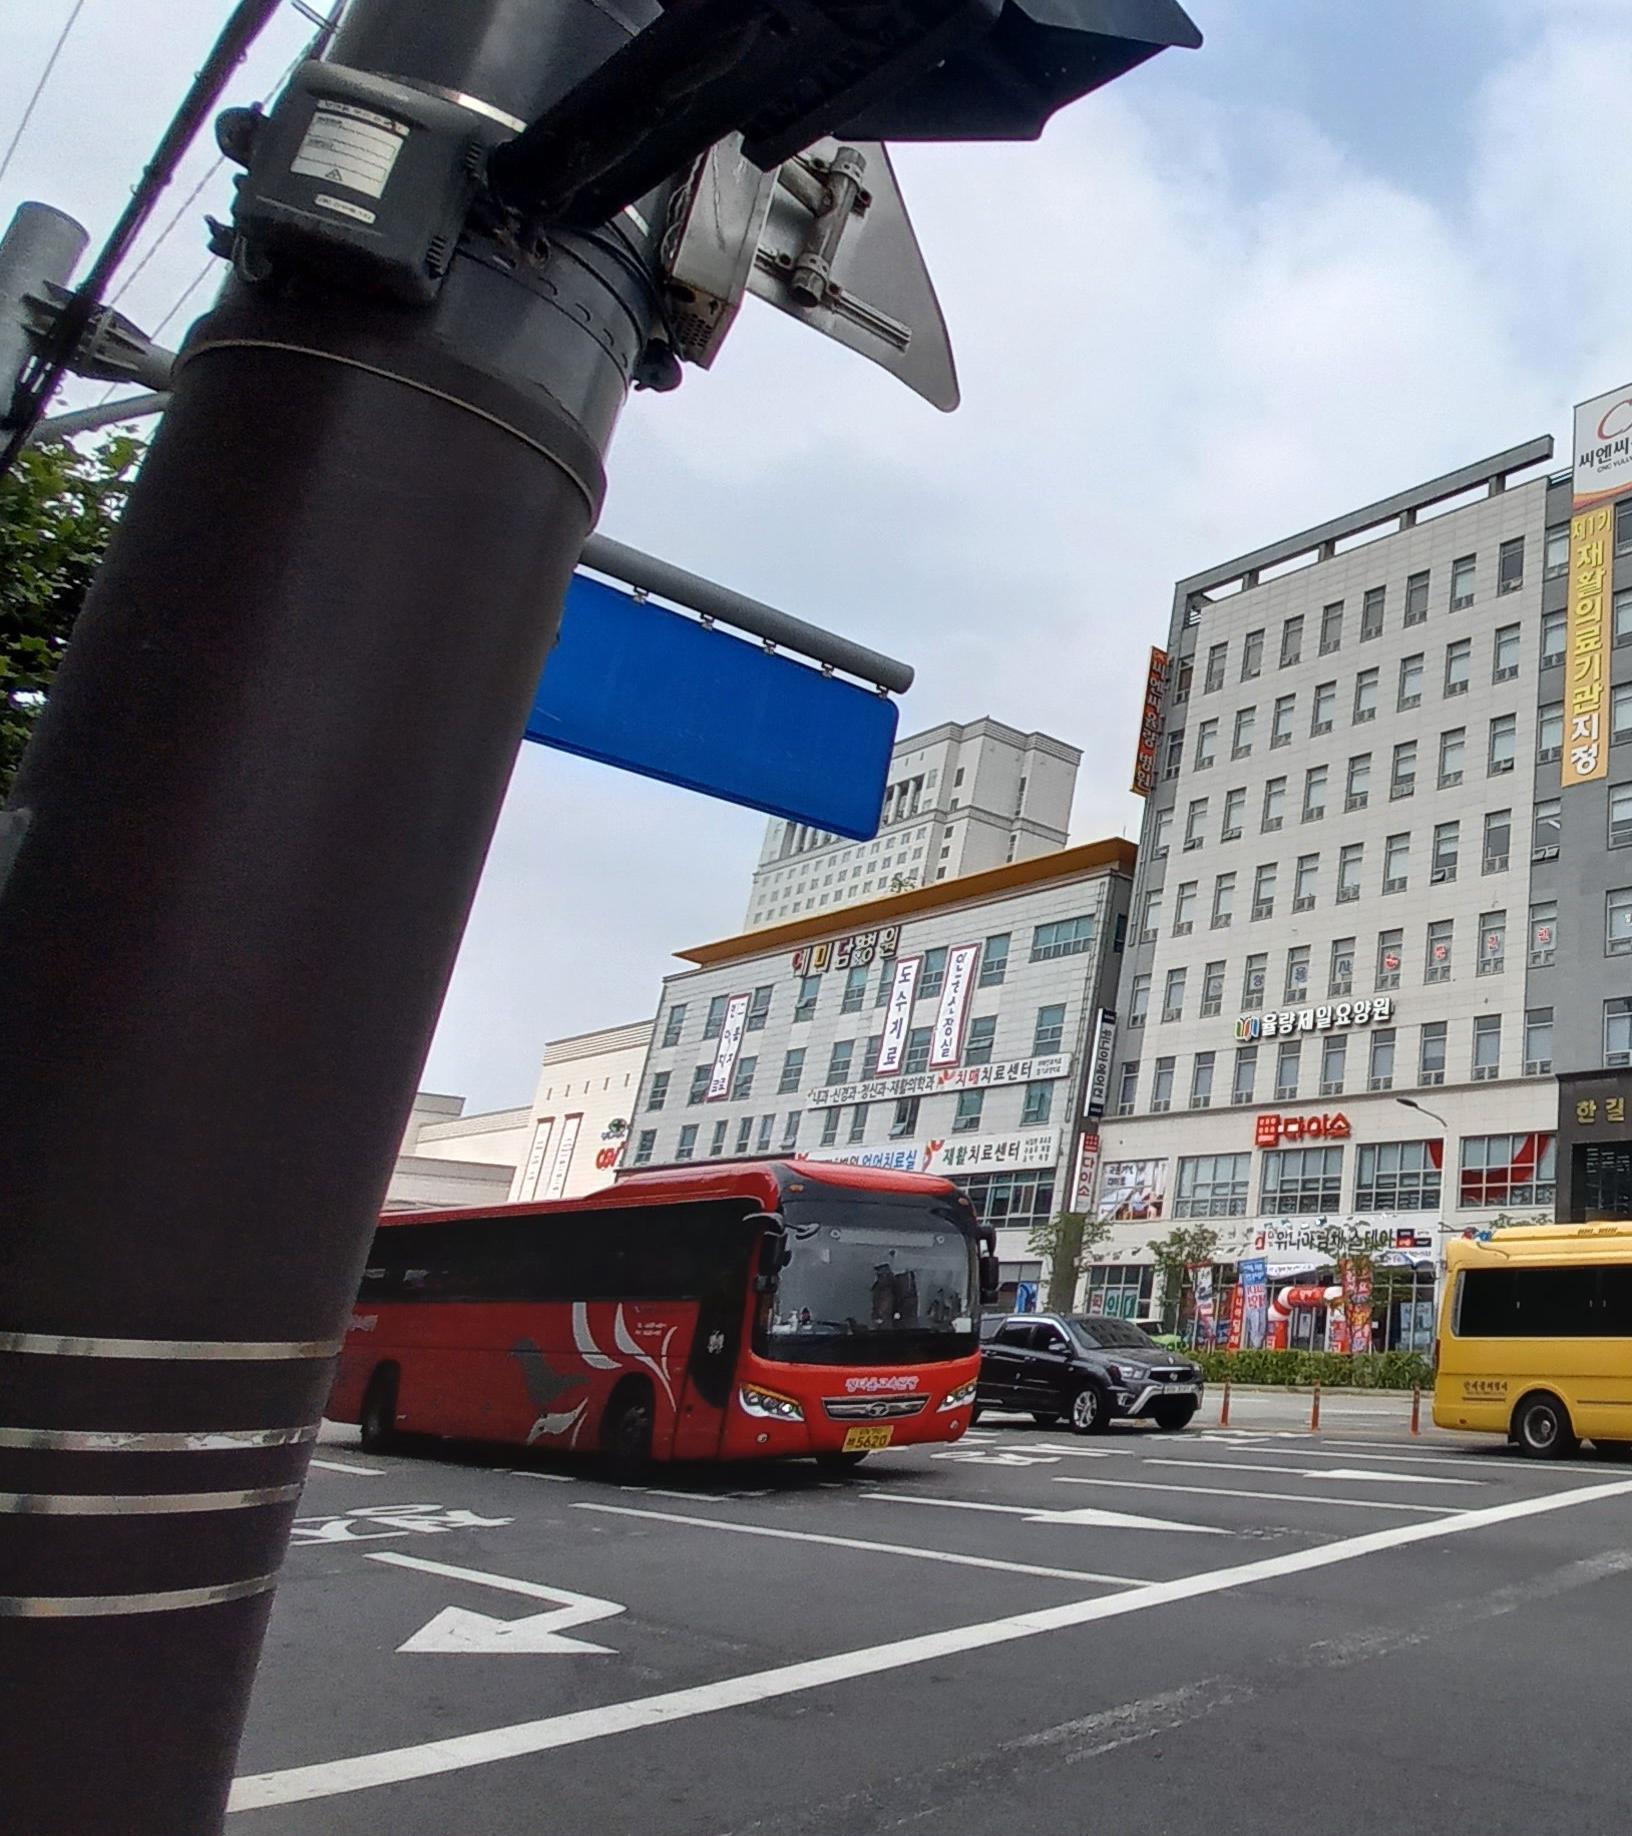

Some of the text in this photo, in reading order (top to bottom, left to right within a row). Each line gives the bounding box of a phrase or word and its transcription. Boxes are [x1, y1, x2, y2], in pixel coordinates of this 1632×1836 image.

[1572, 509, 1612, 542] 제1기
[883, 965, 914, 1066] 도수치료
[1261, 999, 1391, 1036] 율량제일요양원
[955, 1060, 1033, 1086] 치매치료센터
[1283, 1111, 1351, 1141] 다이소
[943, 1139, 1021, 1165] 재활치료센터
[1078, 1157, 1096, 1197] 다이소
